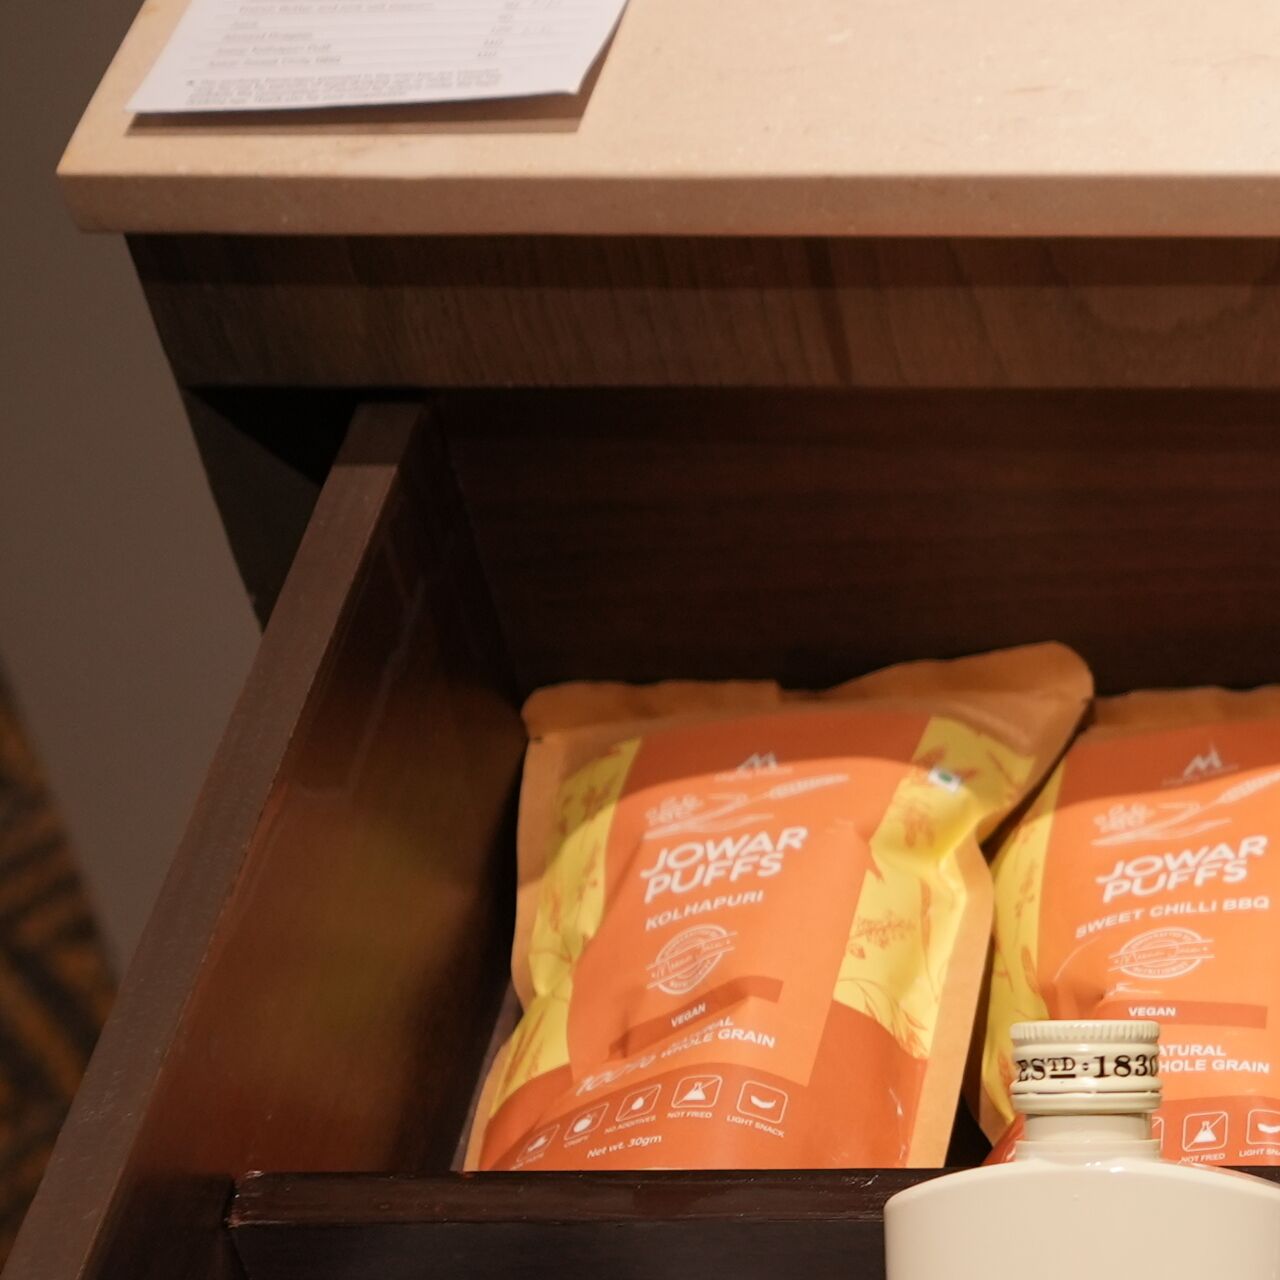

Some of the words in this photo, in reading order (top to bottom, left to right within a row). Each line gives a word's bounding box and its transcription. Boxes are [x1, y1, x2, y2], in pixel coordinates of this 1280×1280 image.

[640, 826, 808, 879] JOWAR
[1095, 835, 1269, 884] JOWAR
[644, 852, 784, 904] PUFFS
[1103, 858, 1247, 904] PUFFS
[645, 890, 765, 931] KOLHAPURI
[1075, 908, 1145, 939] SWEET
[1149, 900, 1217, 918] CHILLI
[1222, 896, 1270, 911] BBQ
[671, 1002, 706, 1028] VEGAN
[1129, 1006, 1176, 1017] VEGAN
[717, 1028, 776, 1049] GRAIN
[1159, 1044, 1226, 1057] ATURAL
[1159, 1059, 1206, 1073] HOLE
[1211, 1060, 1270, 1074] GRAIN
[726, 1114, 755, 1128] LIGHT
